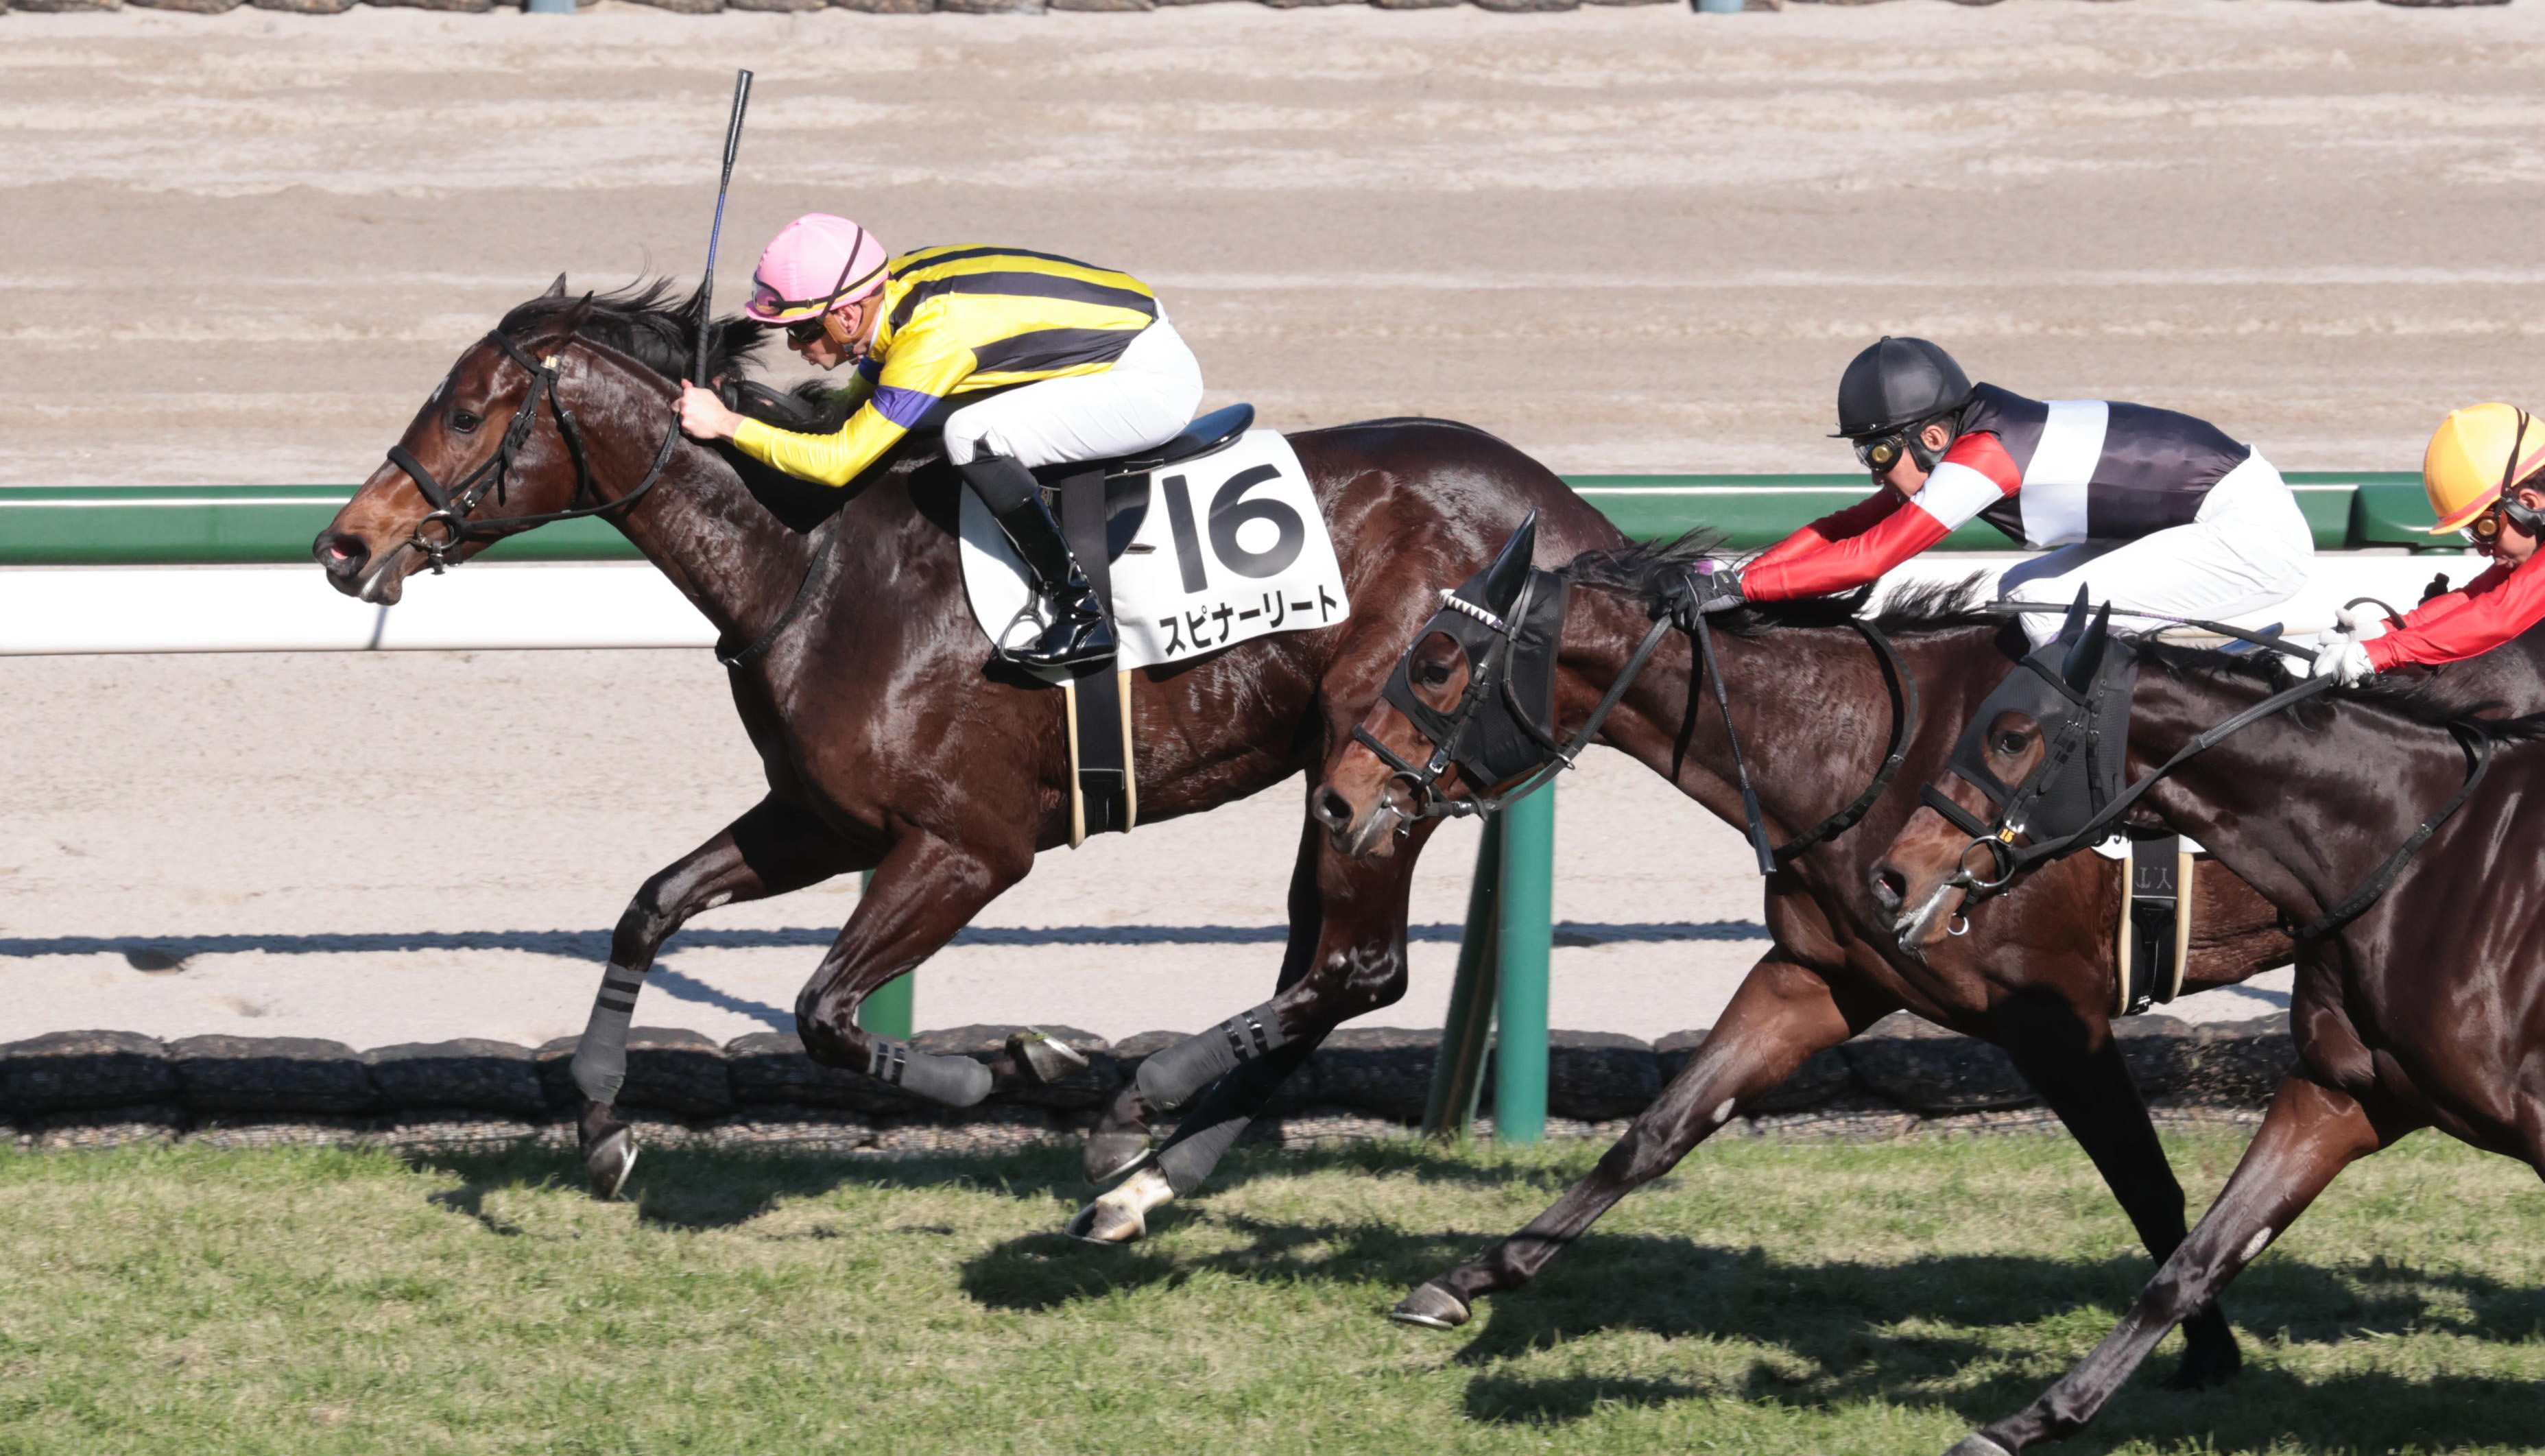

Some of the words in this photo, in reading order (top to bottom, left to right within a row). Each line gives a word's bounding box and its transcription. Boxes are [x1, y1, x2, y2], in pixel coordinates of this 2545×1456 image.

[1162, 464, 1304, 594] 16
[1159, 584, 1337, 657] スピナーリート
[1999, 828, 2014, 843] 15
